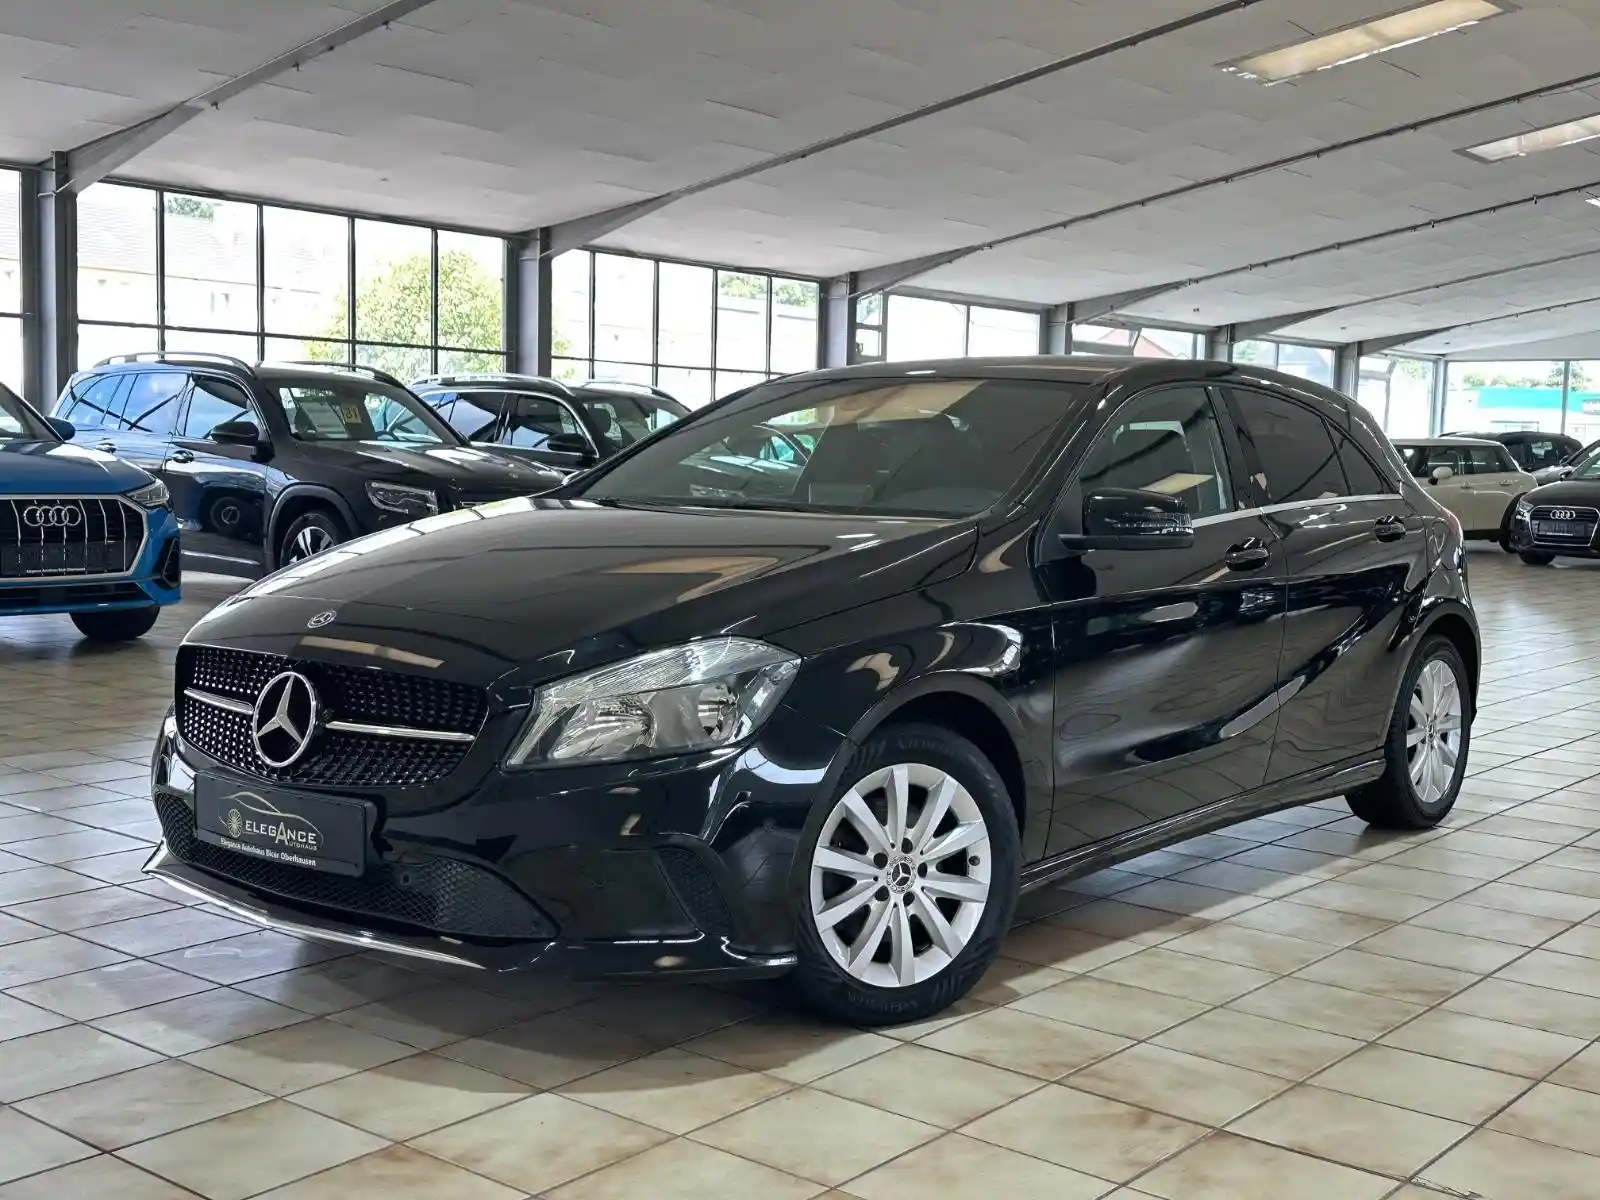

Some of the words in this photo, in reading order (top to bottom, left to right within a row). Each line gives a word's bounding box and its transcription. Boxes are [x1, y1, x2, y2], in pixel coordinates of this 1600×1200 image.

[245, 820, 317, 845] ELEGANCE
[220, 838, 241, 850] Elegance
[242, 843, 265, 855] Autohaus
[280, 852, 316, 866] Oberhausen
